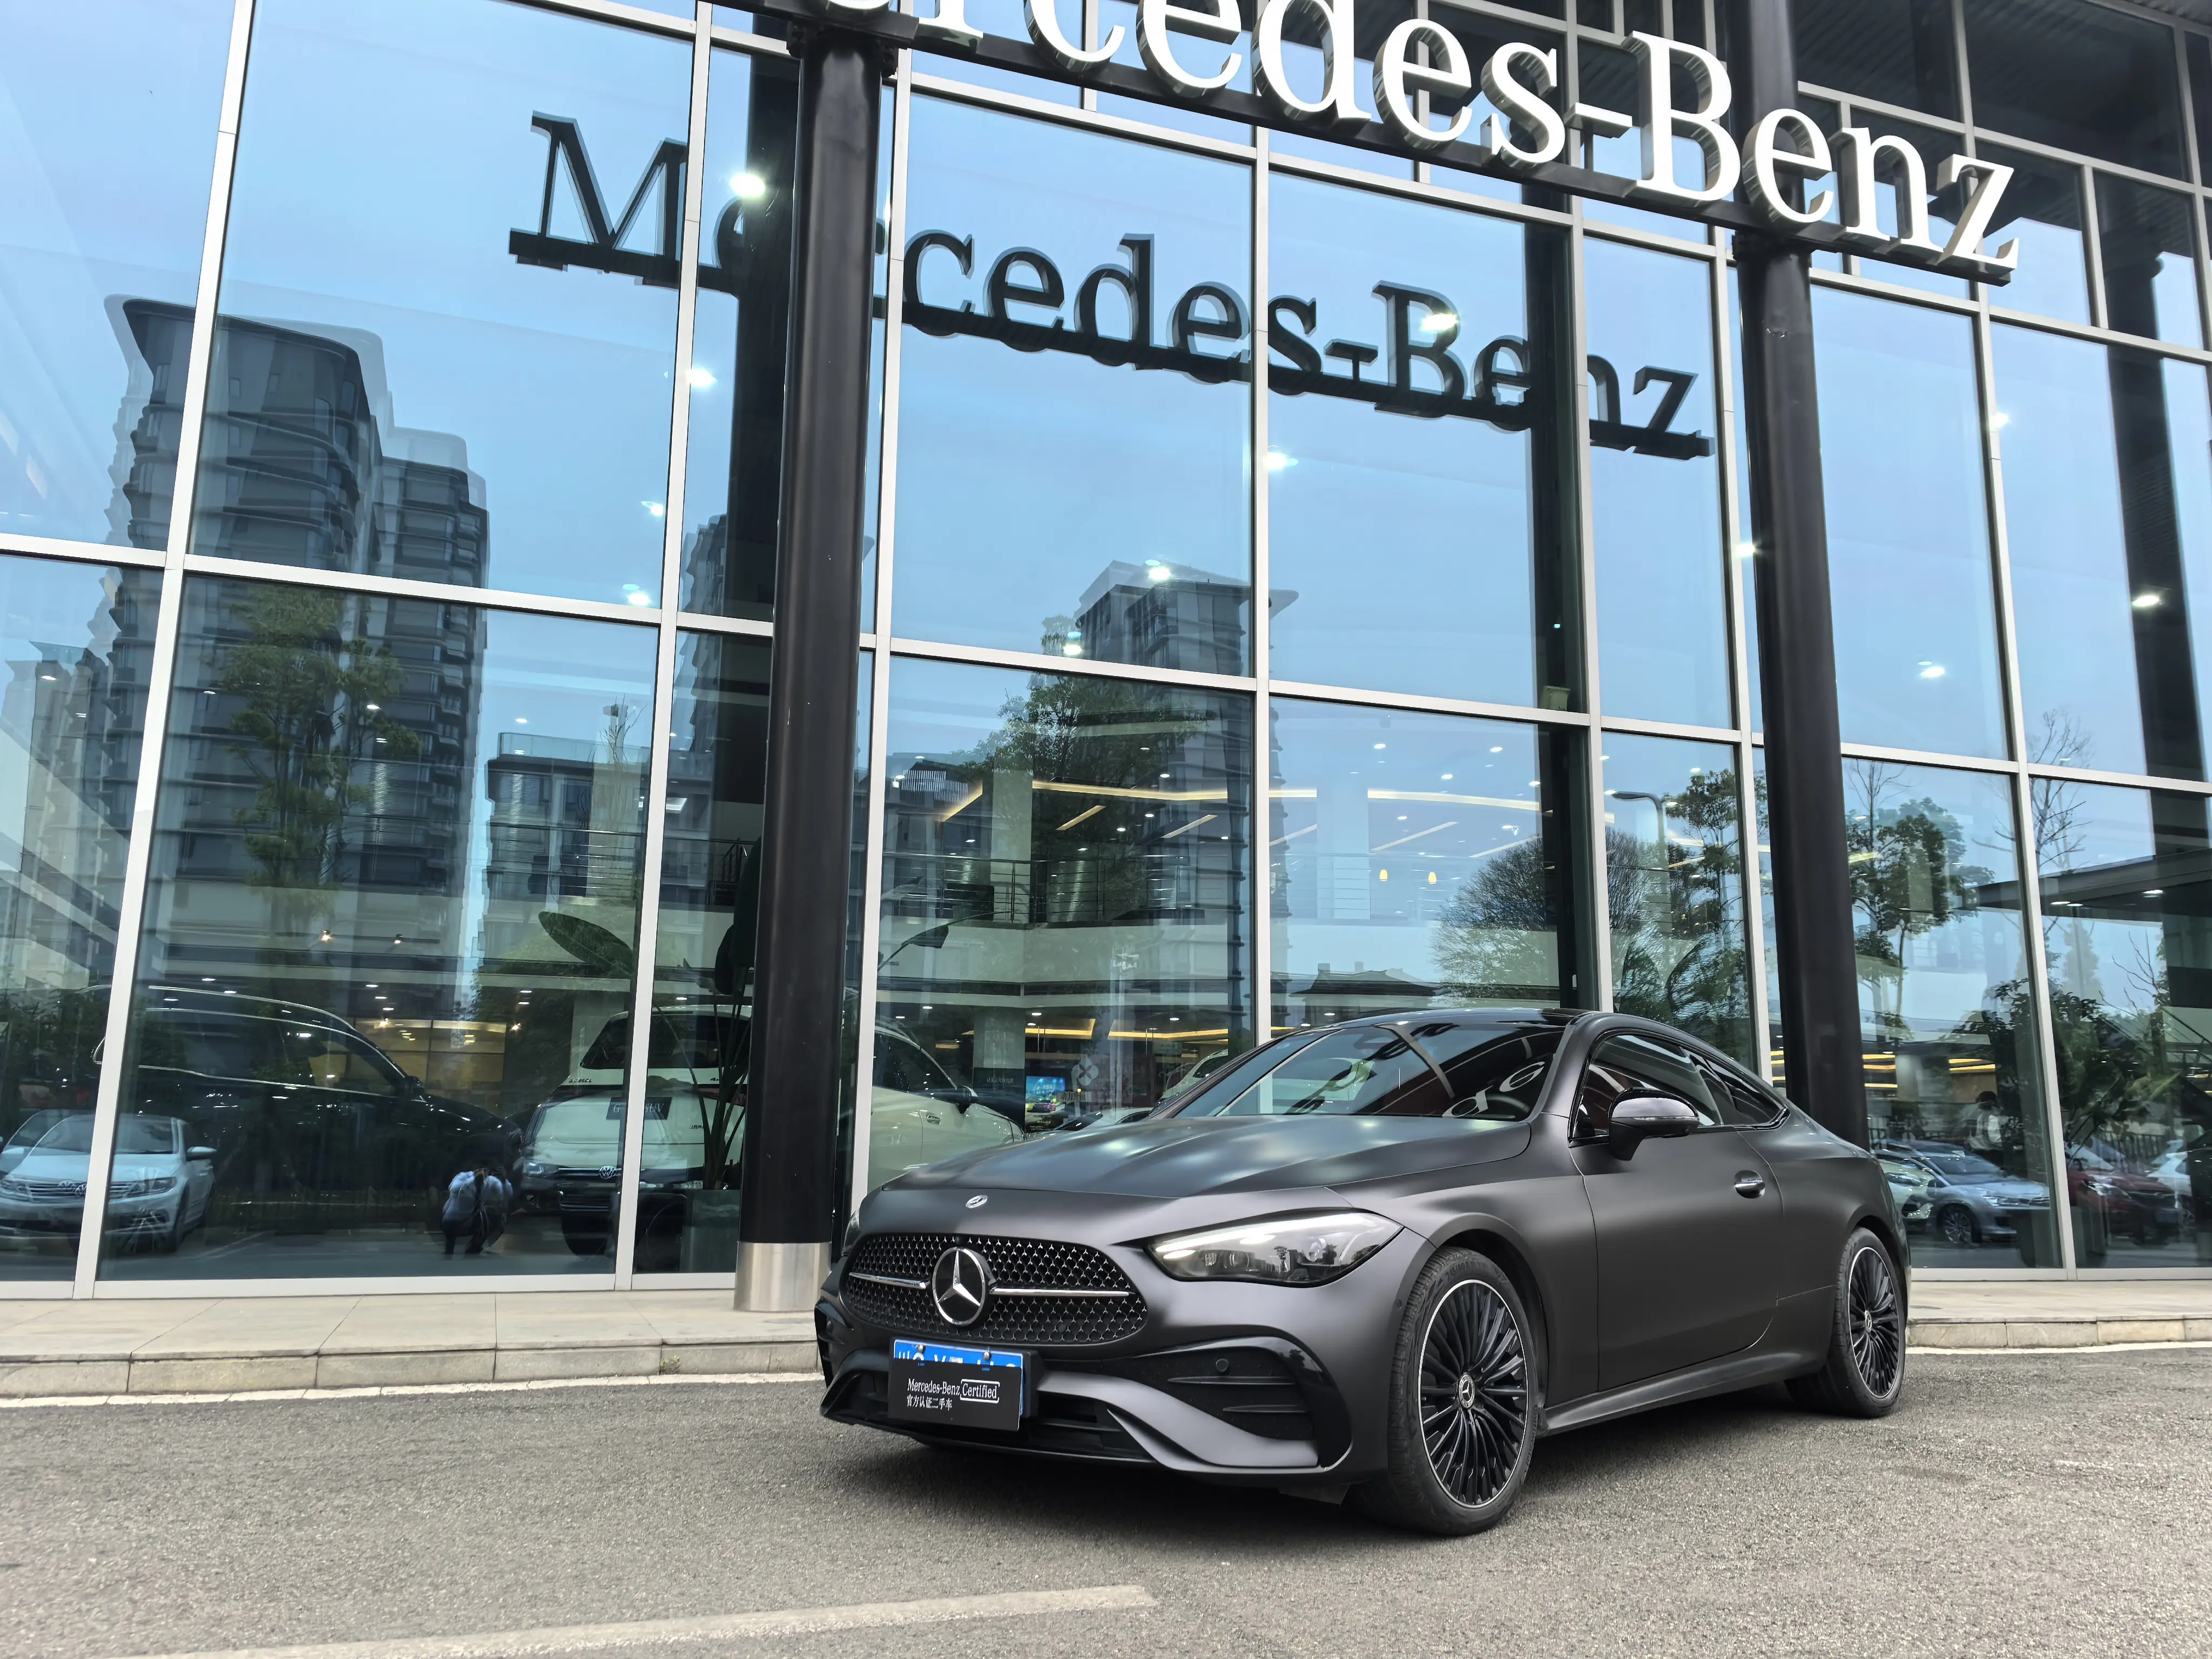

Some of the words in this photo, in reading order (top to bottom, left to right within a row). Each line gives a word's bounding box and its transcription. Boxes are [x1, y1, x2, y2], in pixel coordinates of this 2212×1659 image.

[907, 1378, 960, 1395] Mercedes-Benz
[962, 1382, 997, 1399] Certified
[907, 1394, 953, 1411] 官方认证二手车
